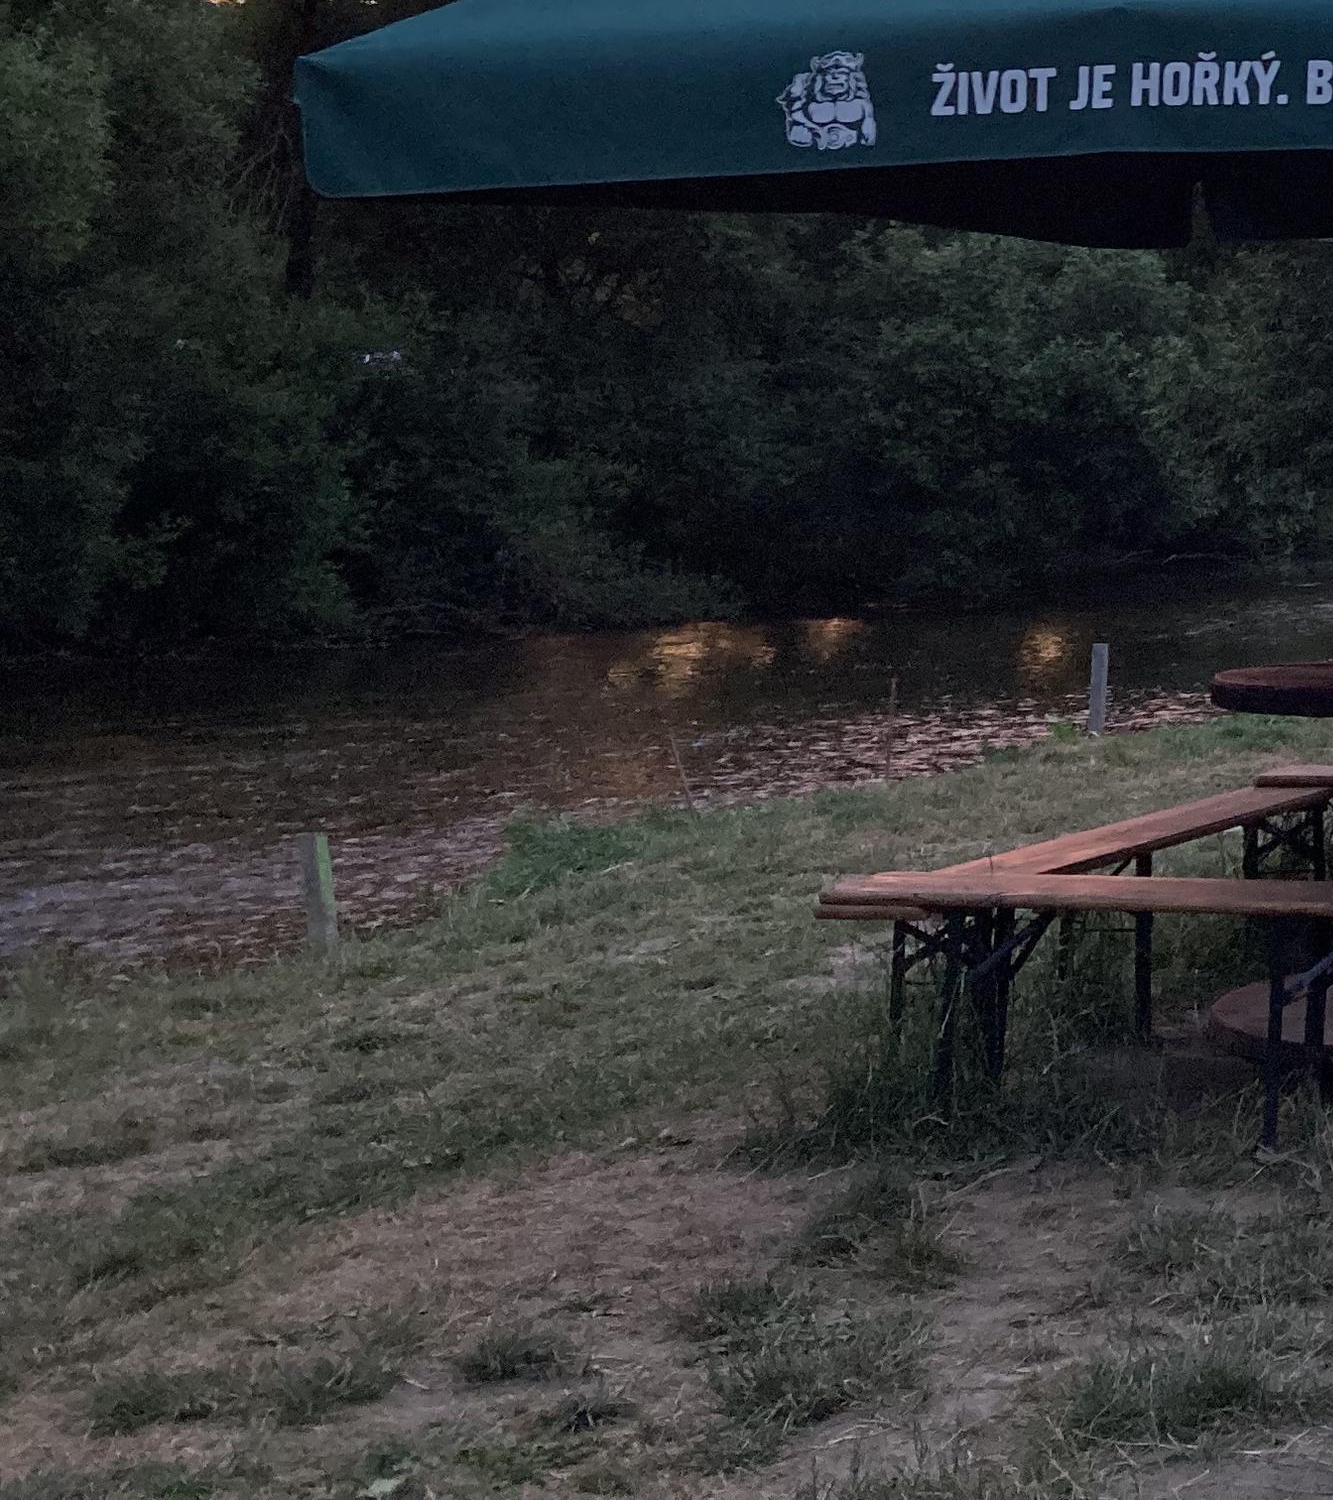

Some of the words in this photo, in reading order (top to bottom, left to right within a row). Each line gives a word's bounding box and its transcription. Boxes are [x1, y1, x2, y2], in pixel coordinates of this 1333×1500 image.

[930, 63, 1057, 116] ŽIVOT
[1069, 64, 1117, 110] JE
[1130, 51, 1289, 106] HOŘKÝ.
